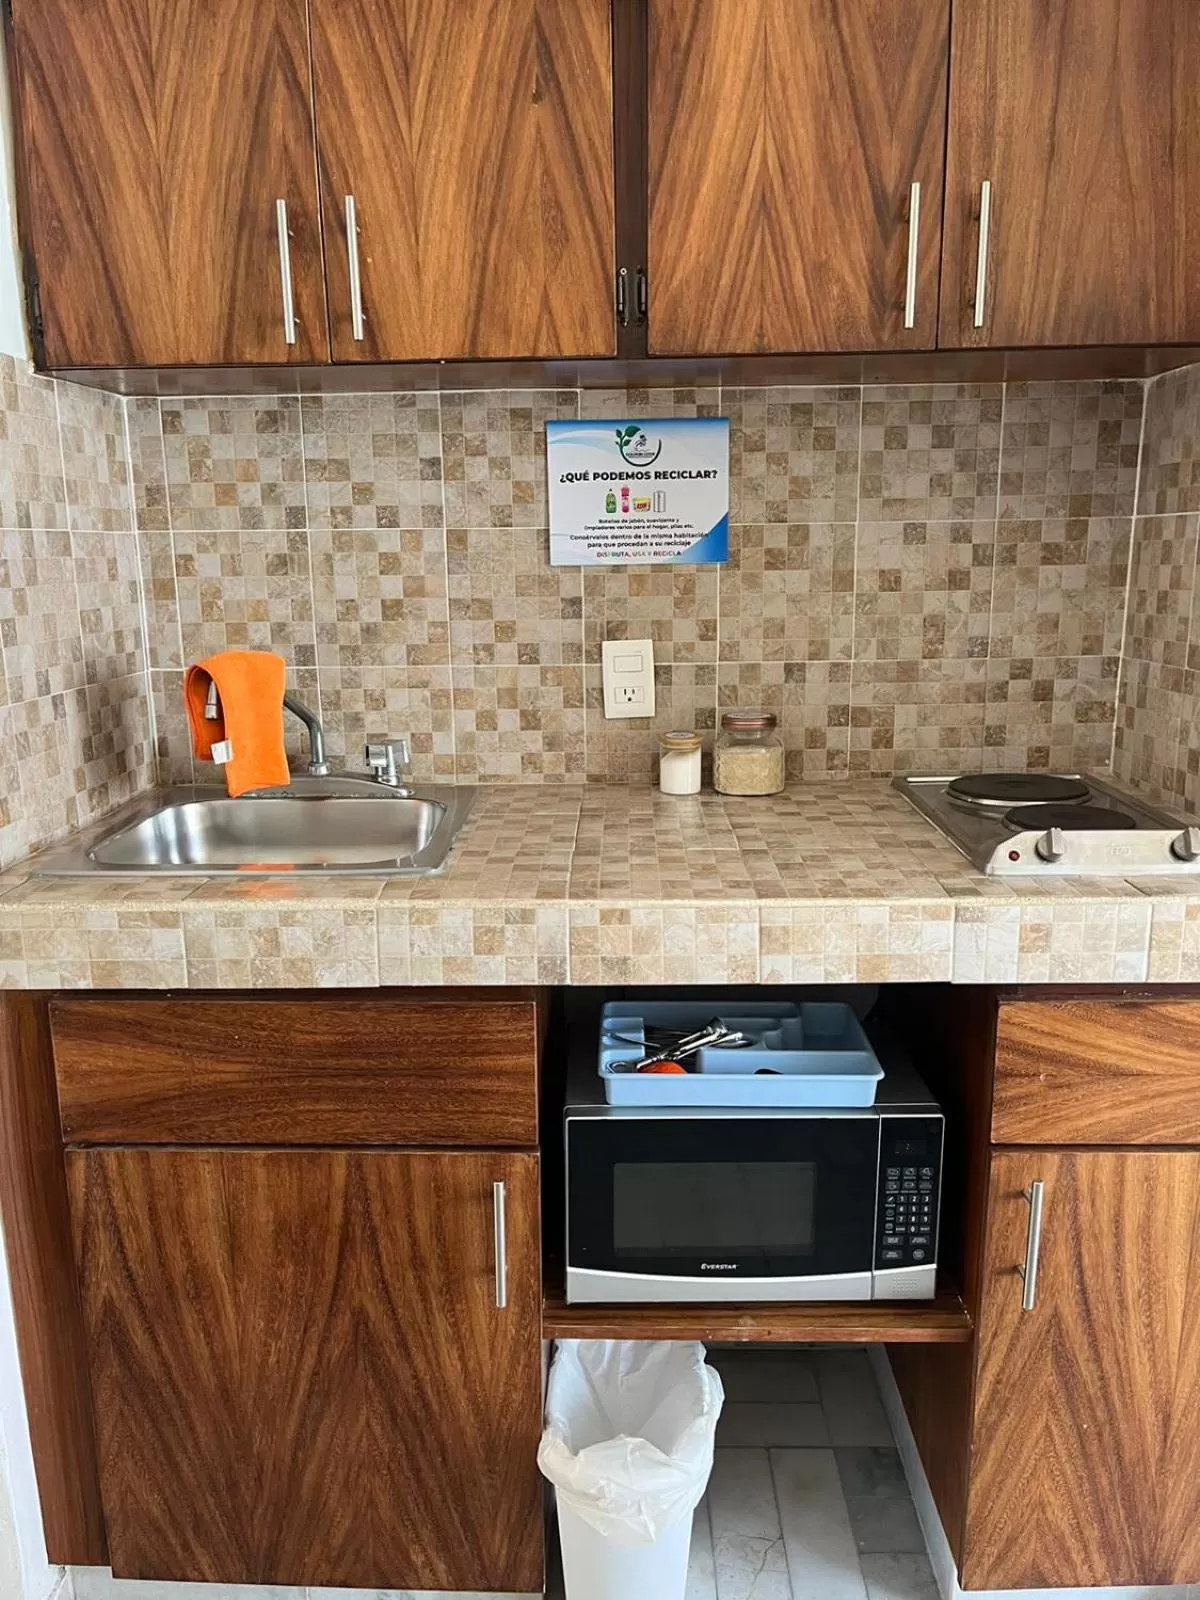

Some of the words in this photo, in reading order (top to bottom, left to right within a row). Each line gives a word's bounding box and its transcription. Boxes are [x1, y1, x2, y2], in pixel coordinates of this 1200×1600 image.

[560, 470, 590, 483] ¿QUÉ
[593, 471, 651, 481] PODEMOS
[654, 470, 718, 480] RECICLAR?
[674, 531, 709, 539] habitación
